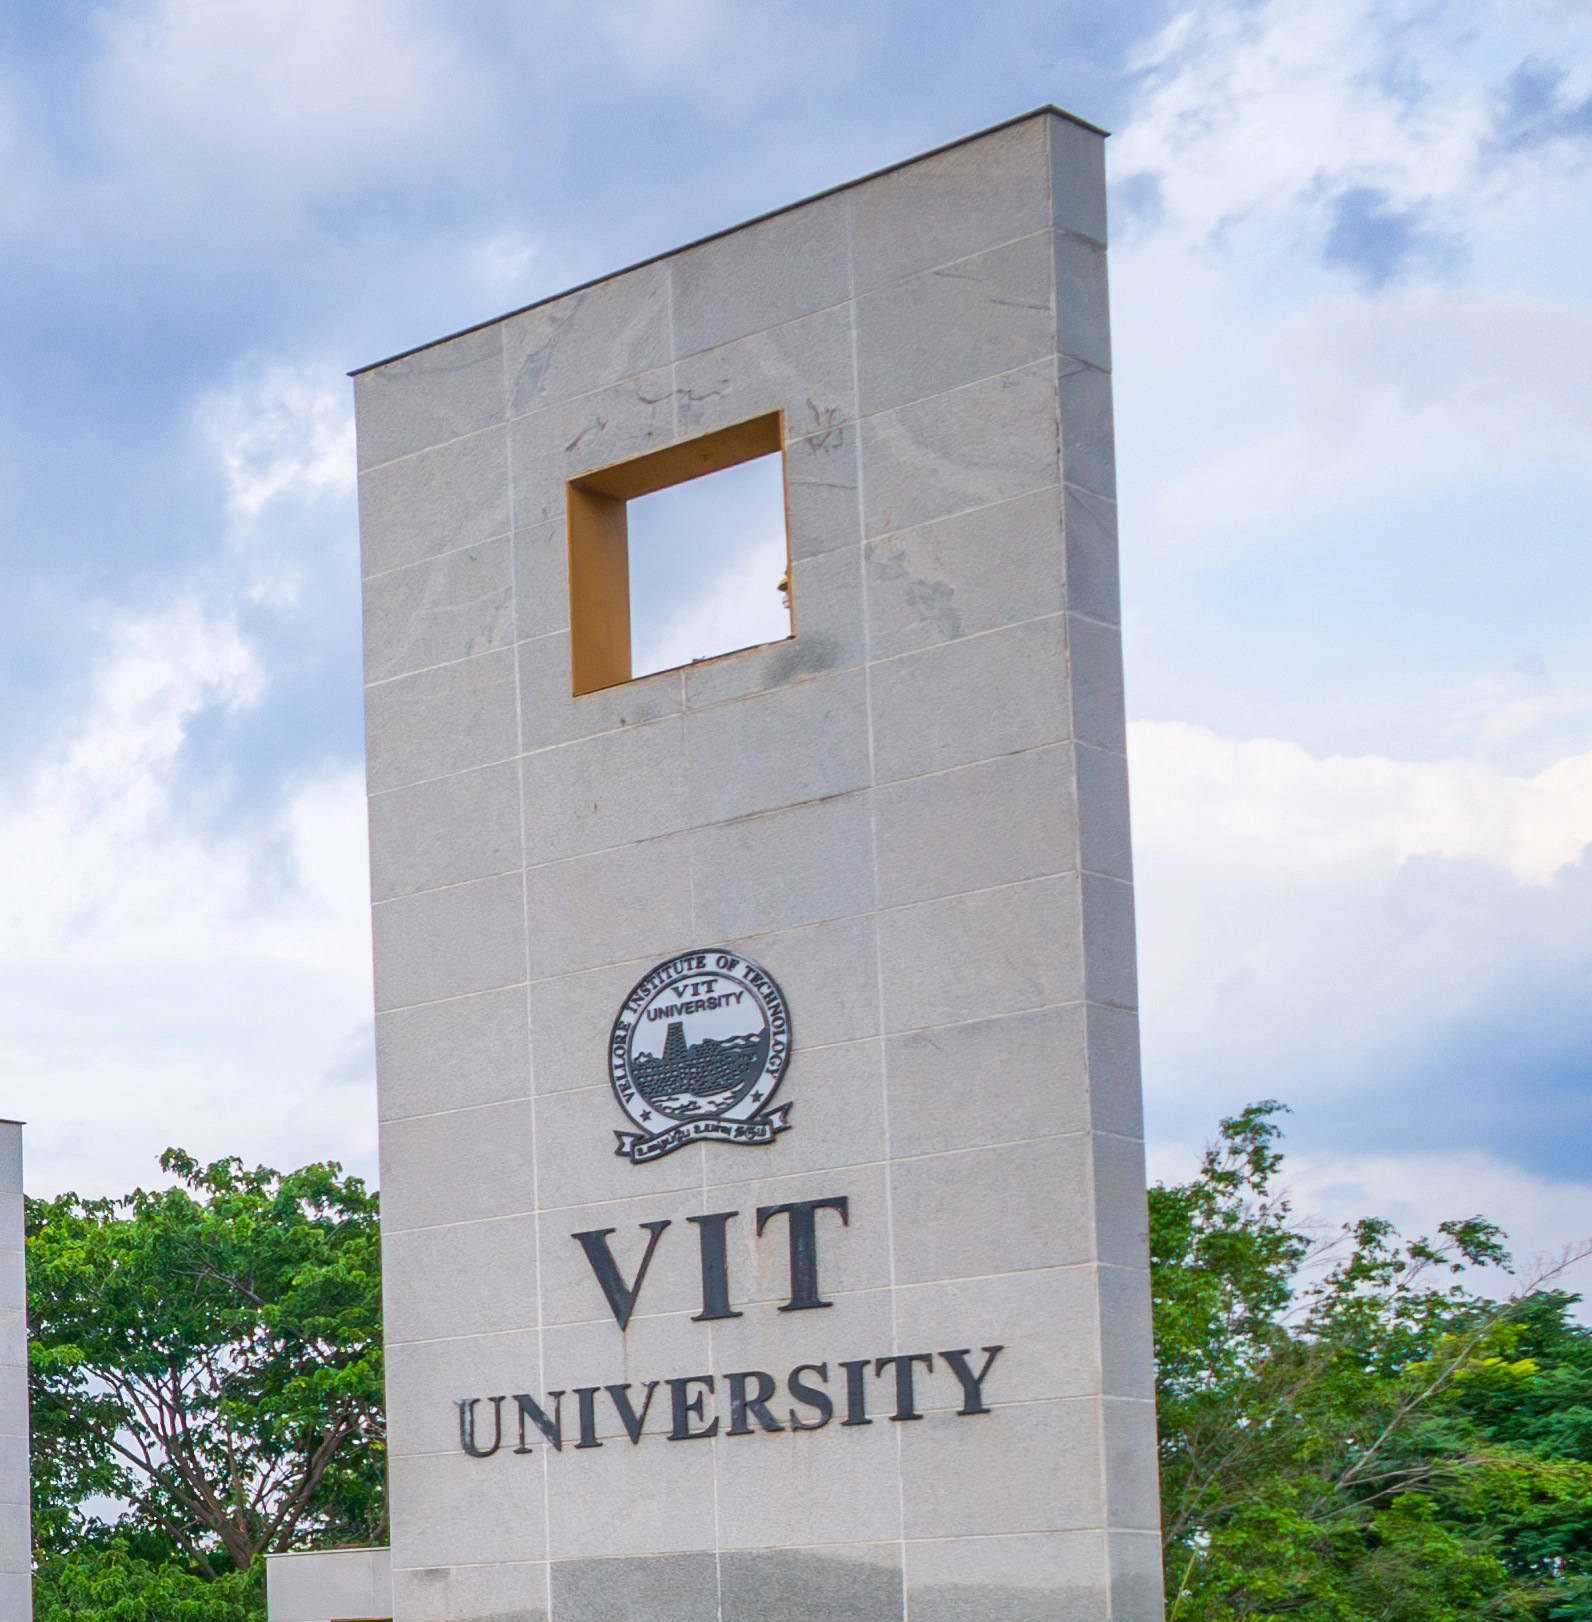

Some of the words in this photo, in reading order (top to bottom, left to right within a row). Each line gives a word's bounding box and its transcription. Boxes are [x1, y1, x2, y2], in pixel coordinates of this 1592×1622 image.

[614, 1020, 635, 1105] VELLORE
[626, 956, 706, 1014] INSTITUTE
[716, 956, 740, 971] OF
[743, 965, 786, 1079] TECHNOLOGY
[646, 990, 744, 1022] UNIVERSITY
[671, 979, 718, 998] VIT
[571, 1196, 849, 1331] VIT
[455, 1345, 1004, 1458] UNIVERSITY
